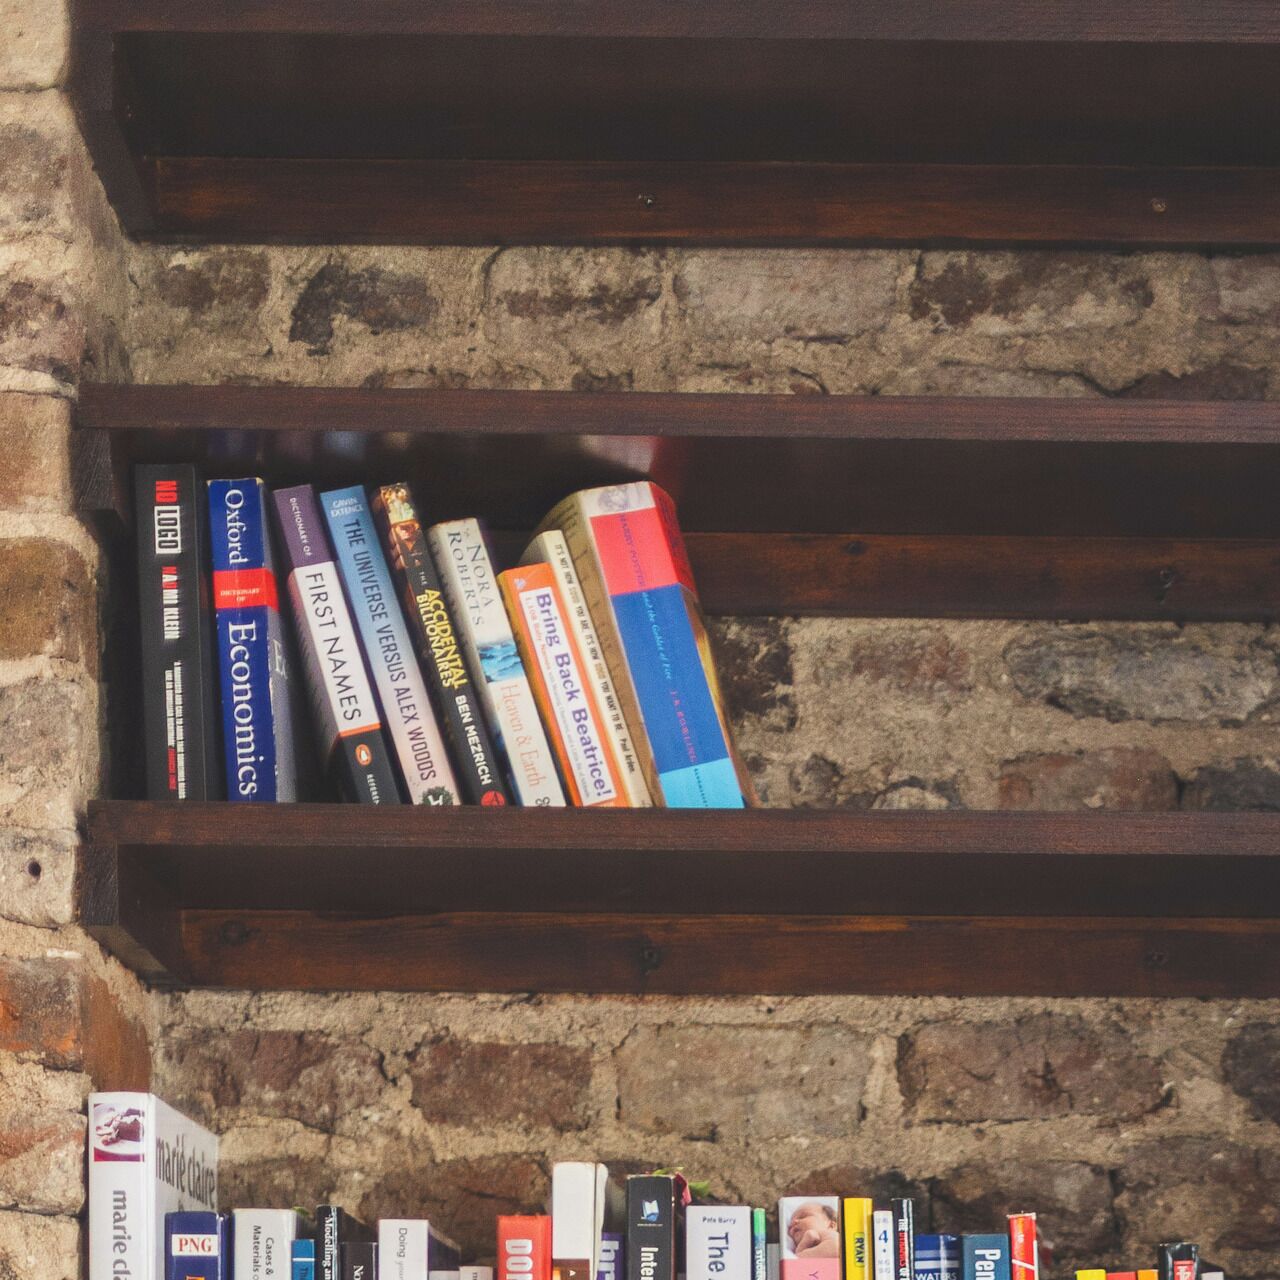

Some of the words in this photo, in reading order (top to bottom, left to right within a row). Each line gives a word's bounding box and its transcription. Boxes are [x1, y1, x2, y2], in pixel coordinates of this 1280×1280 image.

[156, 481, 176, 502] NO
[331, 504, 364, 517] EXTENCE
[332, 498, 358, 508] GAVIN
[157, 510, 178, 549] LOGO
[224, 489, 248, 565] Oxford
[289, 497, 307, 543] DICTIONARY
[303, 546, 312, 556] OF
[344, 519, 365, 547] THE
[162, 566, 179, 604] NAOMI
[353, 551, 388, 622] UNIVERSE
[419, 572, 427, 585] THE
[447, 532, 484, 626] ROBERTS
[466, 544, 494, 608] NORA
[163, 607, 180, 640] KLEIN
[305, 573, 336, 628] FIRST
[325, 636, 362, 721] NAMES
[416, 594, 453, 688] BILLIONAIRES
[425, 589, 468, 690] ACCIDENTAL
[375, 624, 407, 682] VERSUS
[228, 620, 264, 795] Economics
[394, 688, 419, 724] ALEX
[500, 685, 526, 731] Heaven
[536, 593, 561, 647] Bring
[554, 653, 580, 701] Back
[572, 707, 611, 797] Beatrice!
[407, 727, 436, 781] WOODS
[455, 695, 473, 723] BEN
[465, 726, 492, 785] MEZRICH
[516, 736, 533, 746] &
[520, 750, 547, 788] Earth
[112, 1190, 132, 1254] marie
[179, 1238, 212, 1252] PNG
[322, 1217, 333, 1267] Modelling
[252, 1225, 262, 1273] Materials
[265, 1237, 274, 1266] Cases
[708, 1232, 729, 1272] The
[855, 1237, 864, 1263] RYAN
